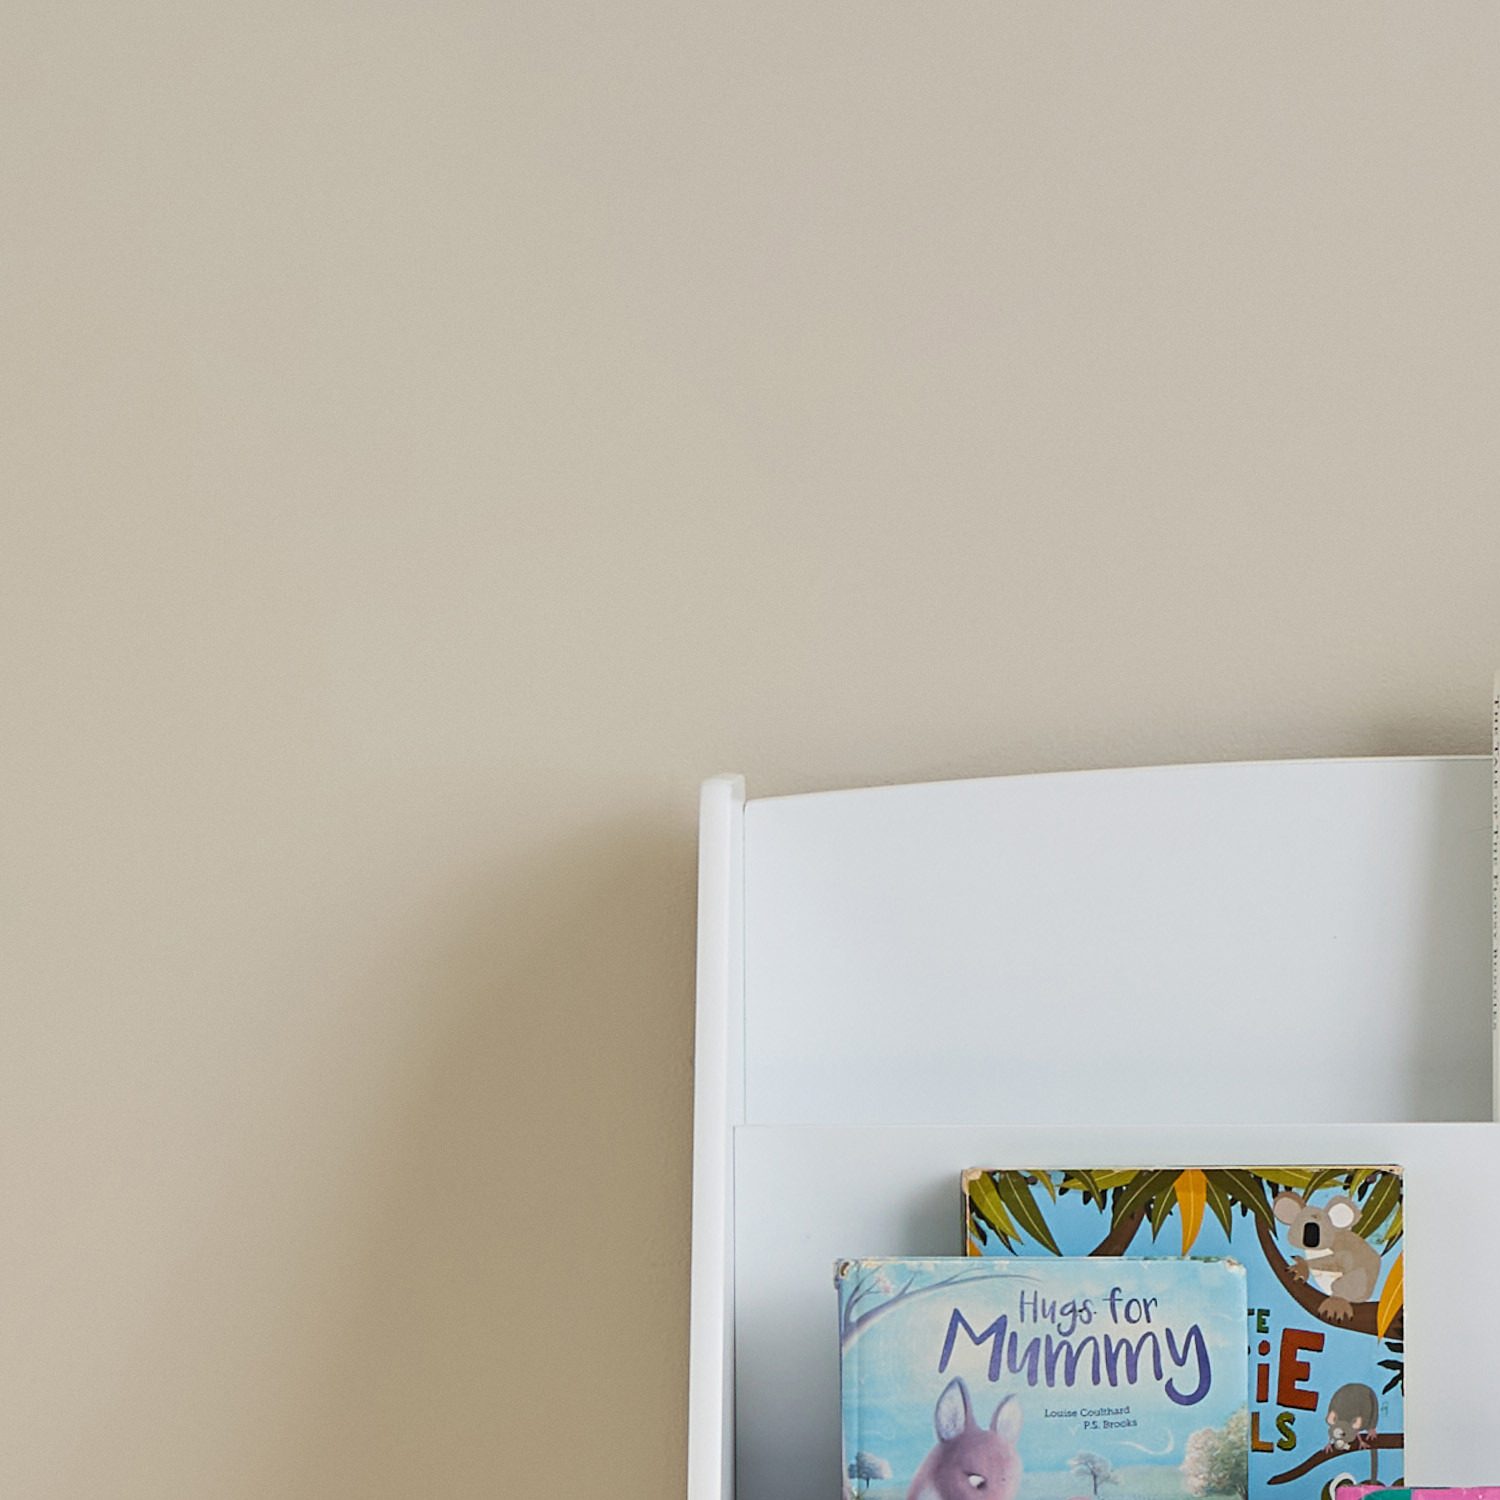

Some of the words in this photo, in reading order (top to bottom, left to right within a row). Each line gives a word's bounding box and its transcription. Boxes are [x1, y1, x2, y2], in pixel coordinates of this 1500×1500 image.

[1020, 1290, 1094, 1337] Hugs
[1103, 1287, 1158, 1324] for
[938, 1308, 1212, 1406] Mummy
[1045, 1409, 1077, 1418] Louise
[1080, 1406, 1130, 1417] Coulthard
[1103, 1419, 1137, 1429] Brooks
